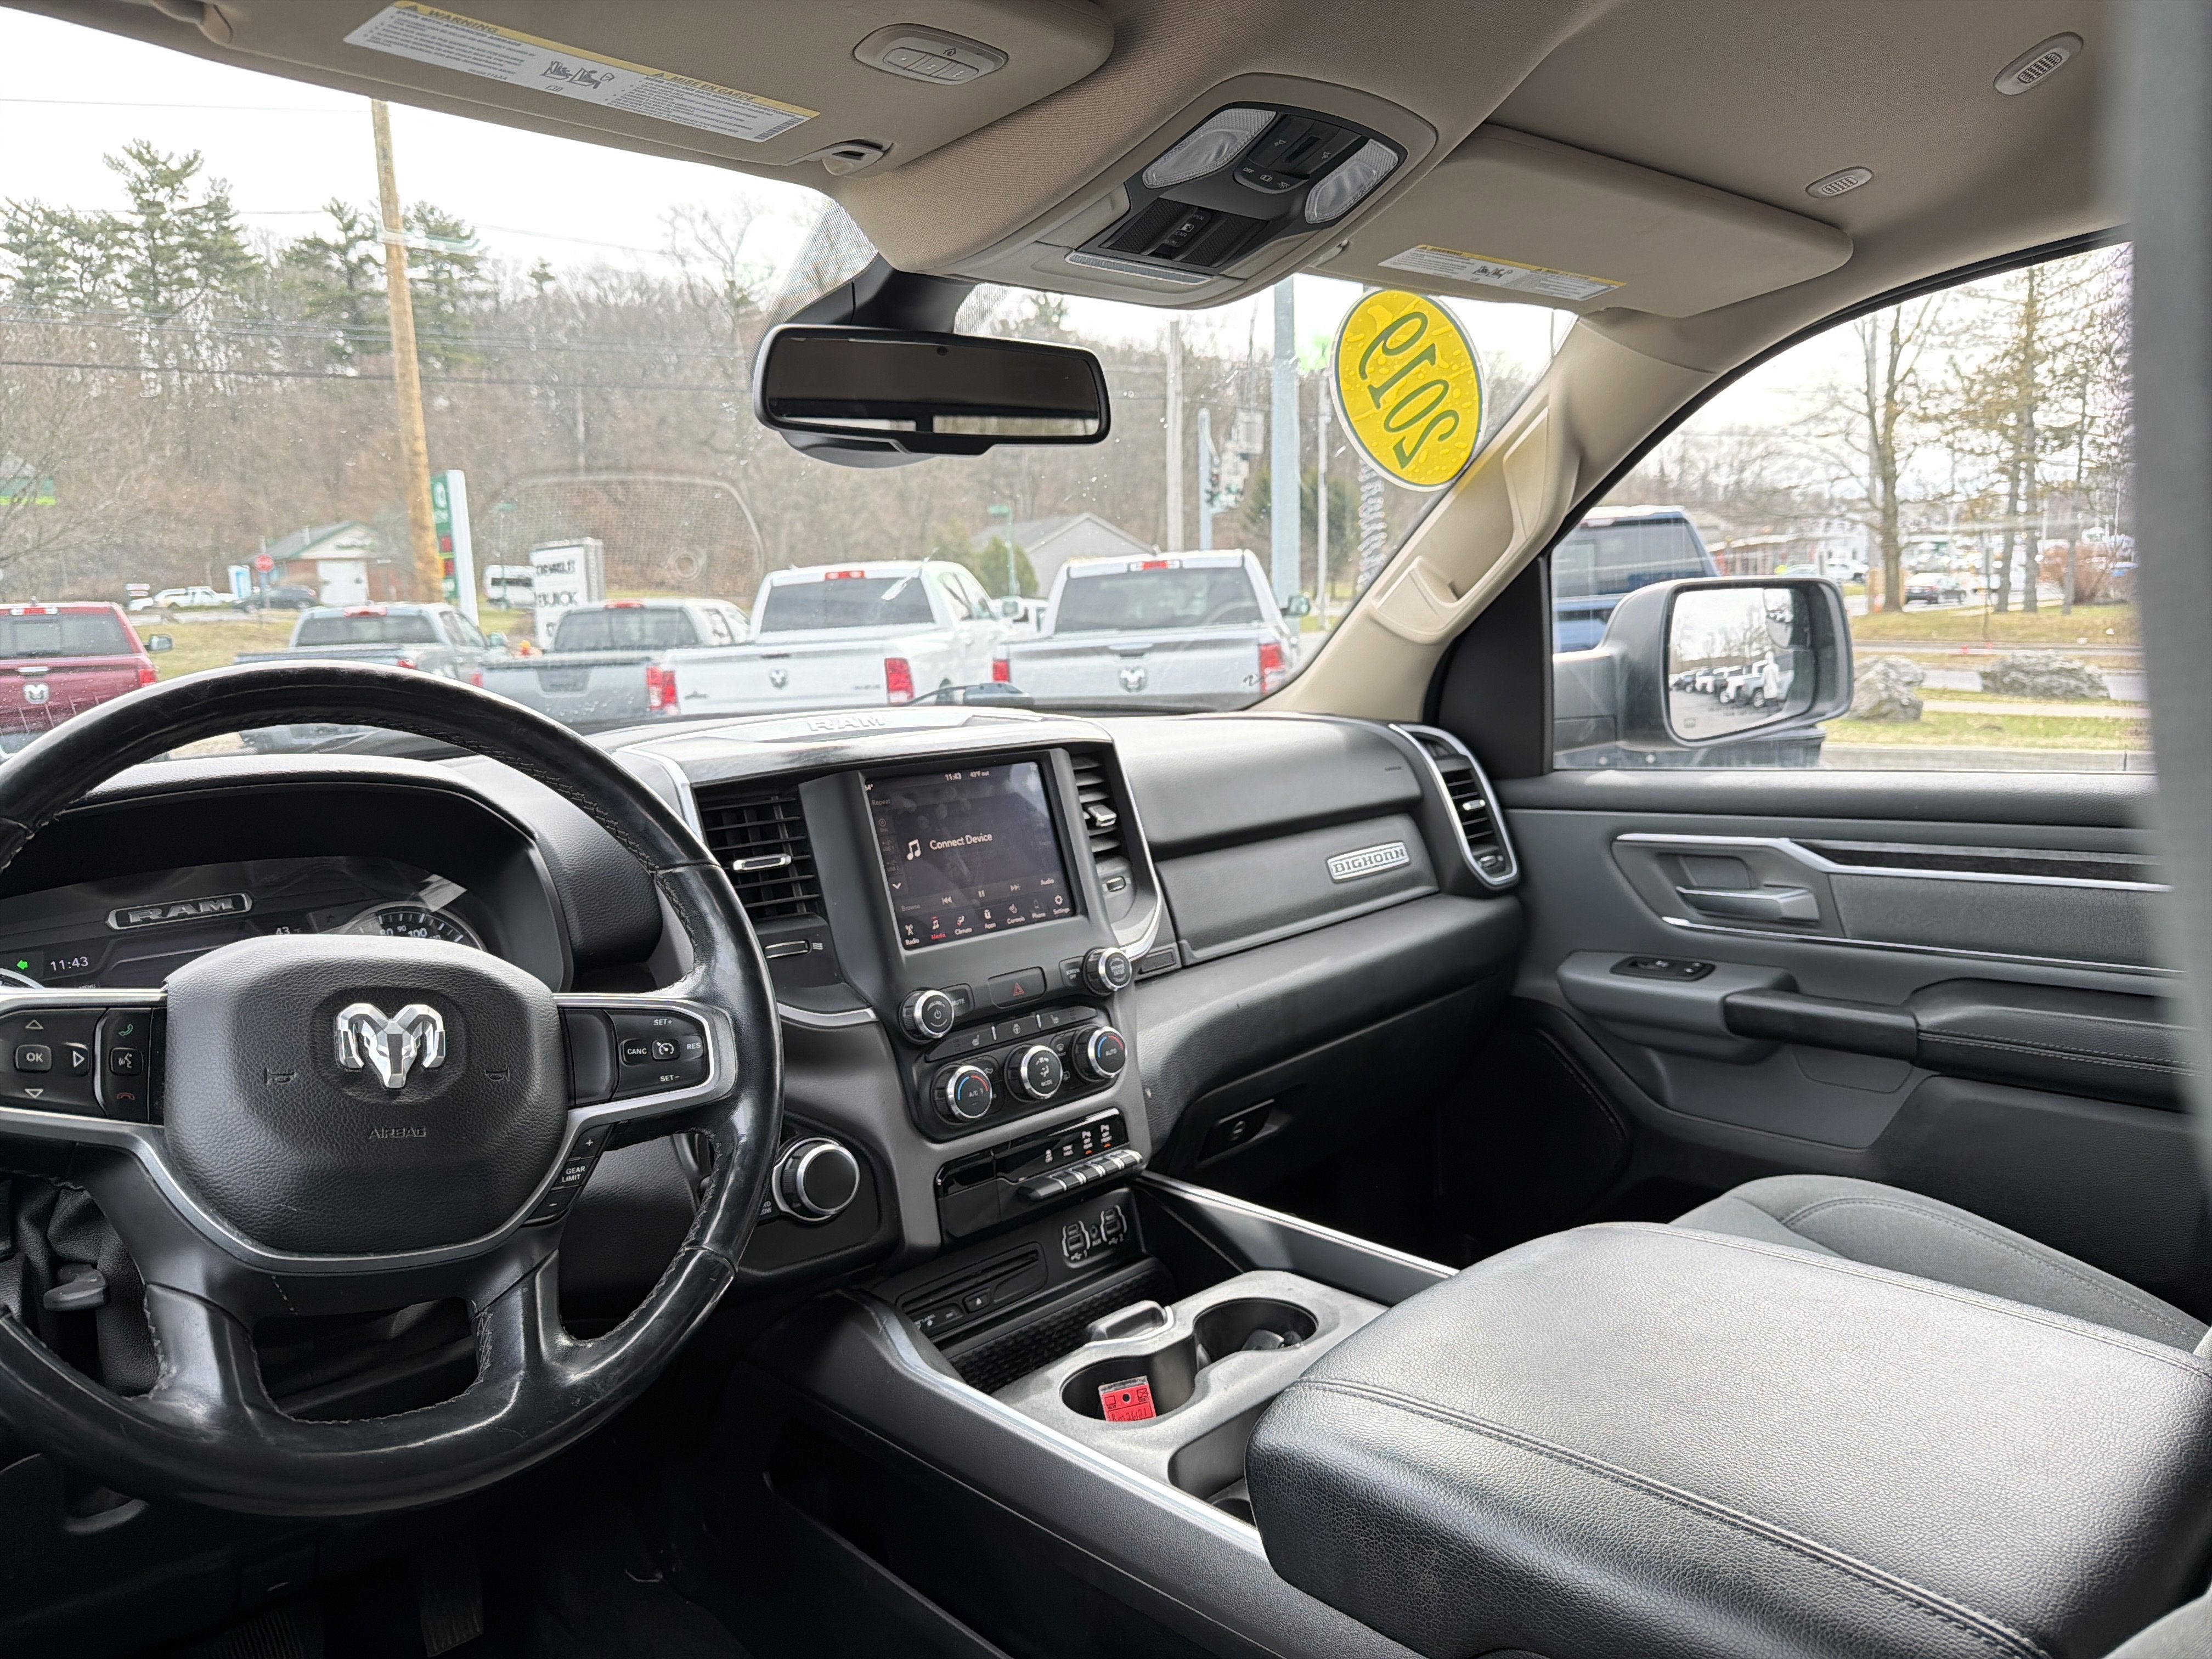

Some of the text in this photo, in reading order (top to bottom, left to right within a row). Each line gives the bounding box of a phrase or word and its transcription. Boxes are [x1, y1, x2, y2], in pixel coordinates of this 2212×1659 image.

[428, 9, 499, 33] WARNING
[670, 75, 702, 87] MISE
[718, 86, 756, 100] GARDE
[807, 714, 885, 732] RAM
[944, 772, 962, 781] 11:43
[929, 833, 993, 850] Connect Device
[1333, 848, 1405, 873] BIGHORN
[129, 899, 234, 923] RAM
[1006, 916, 1025, 924] Controls
[275, 926, 291, 934] 43
[407, 928, 427, 938] 100
[50, 956, 89, 971] 11:43
[951, 998, 966, 1006] MUTE
[627, 1047, 647, 1056] CANC
[686, 1042, 702, 1051] RES
[26, 1052, 44, 1063] OK
[1105, 1048, 1118, 1057] AUTO
[368, 1126, 427, 1139] AIRBAG
[566, 1165, 585, 1175] GEAR
[561, 1173, 582, 1183] LIMIT
